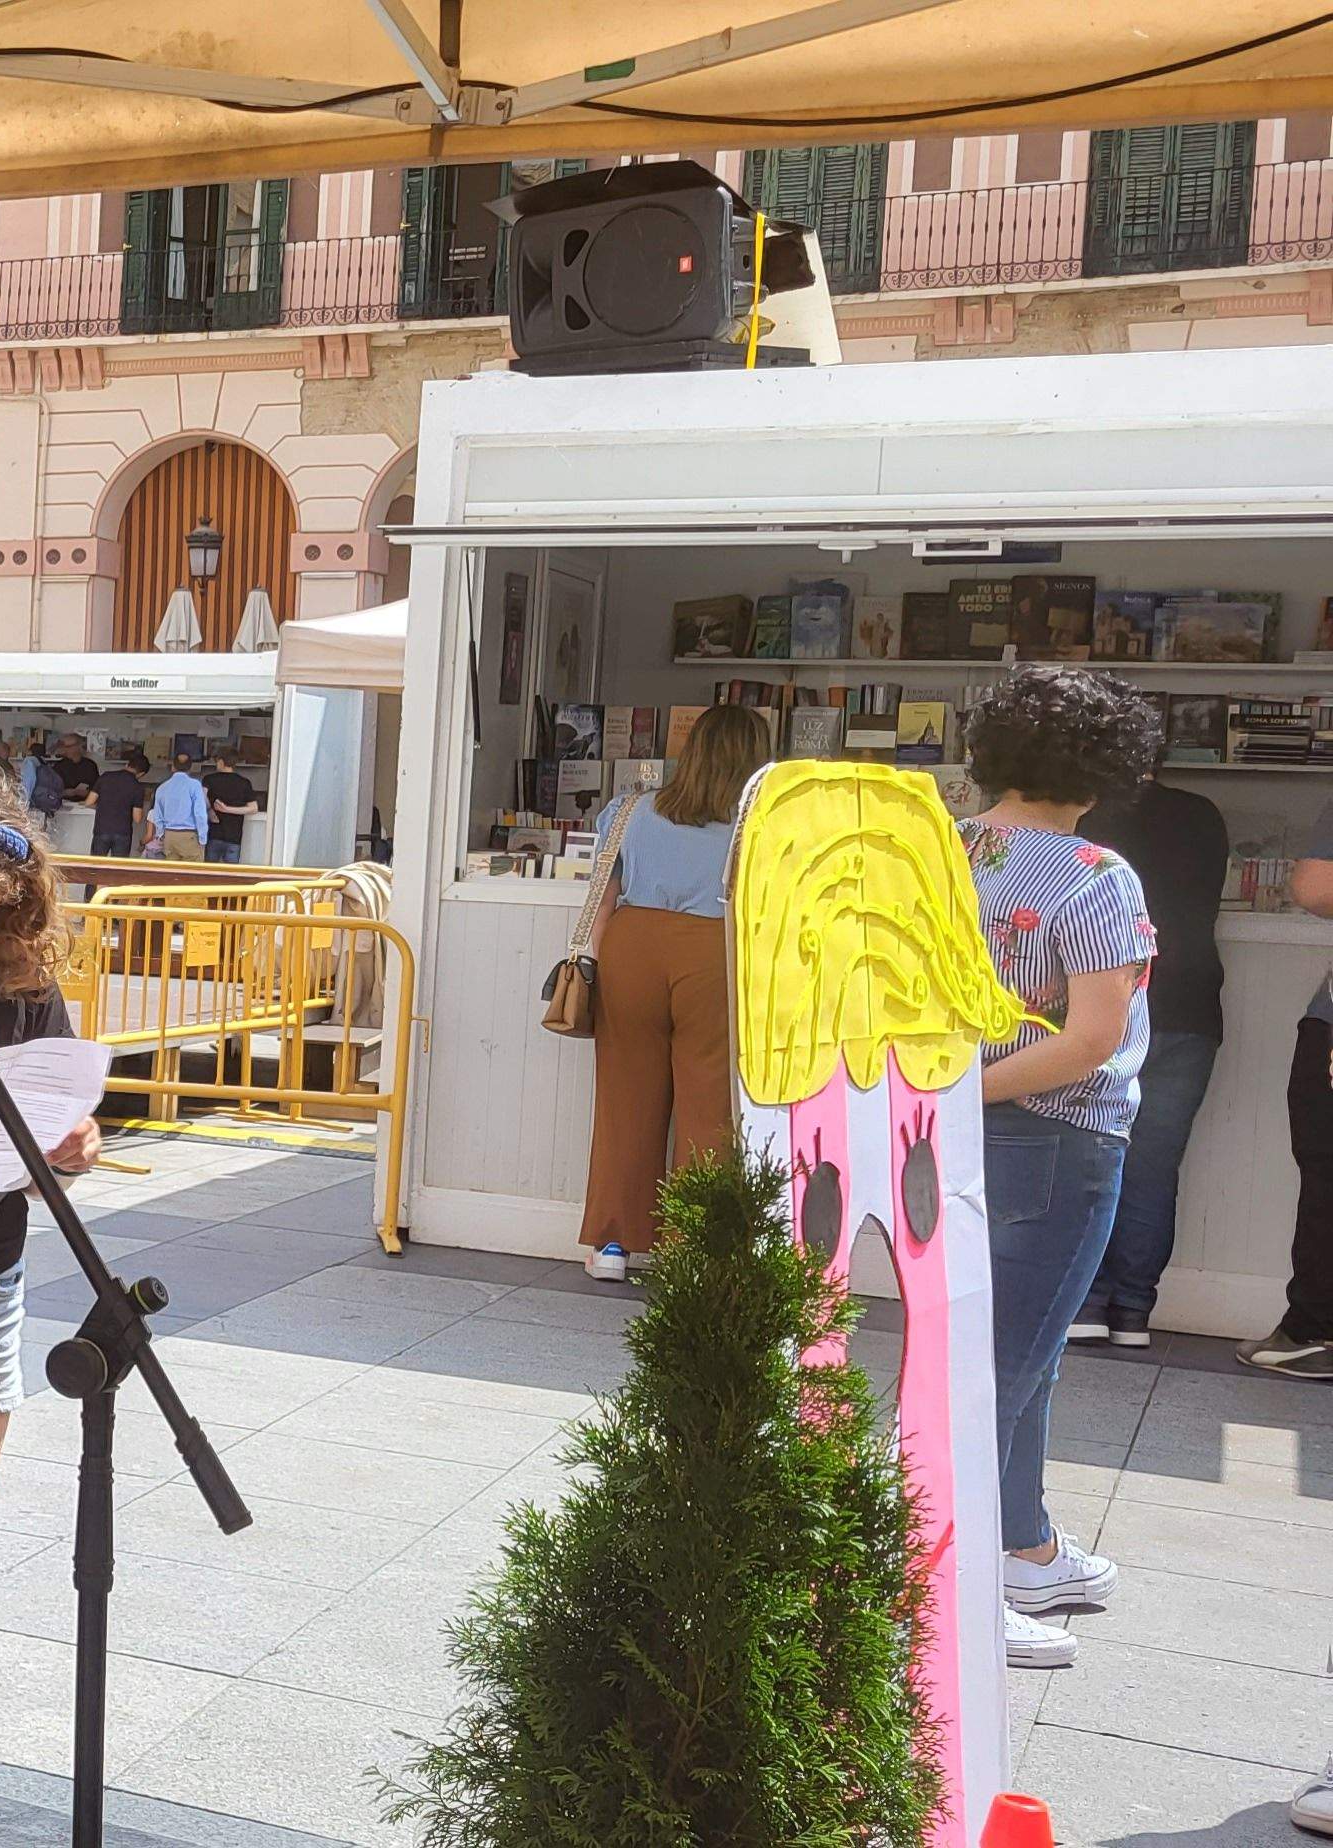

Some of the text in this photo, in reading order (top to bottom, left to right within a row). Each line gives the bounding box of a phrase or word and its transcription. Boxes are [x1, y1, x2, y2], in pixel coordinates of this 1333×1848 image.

[958, 595, 993, 603] ANTES
[959, 604, 993, 612] TODO
[131, 677, 159, 688] editor
